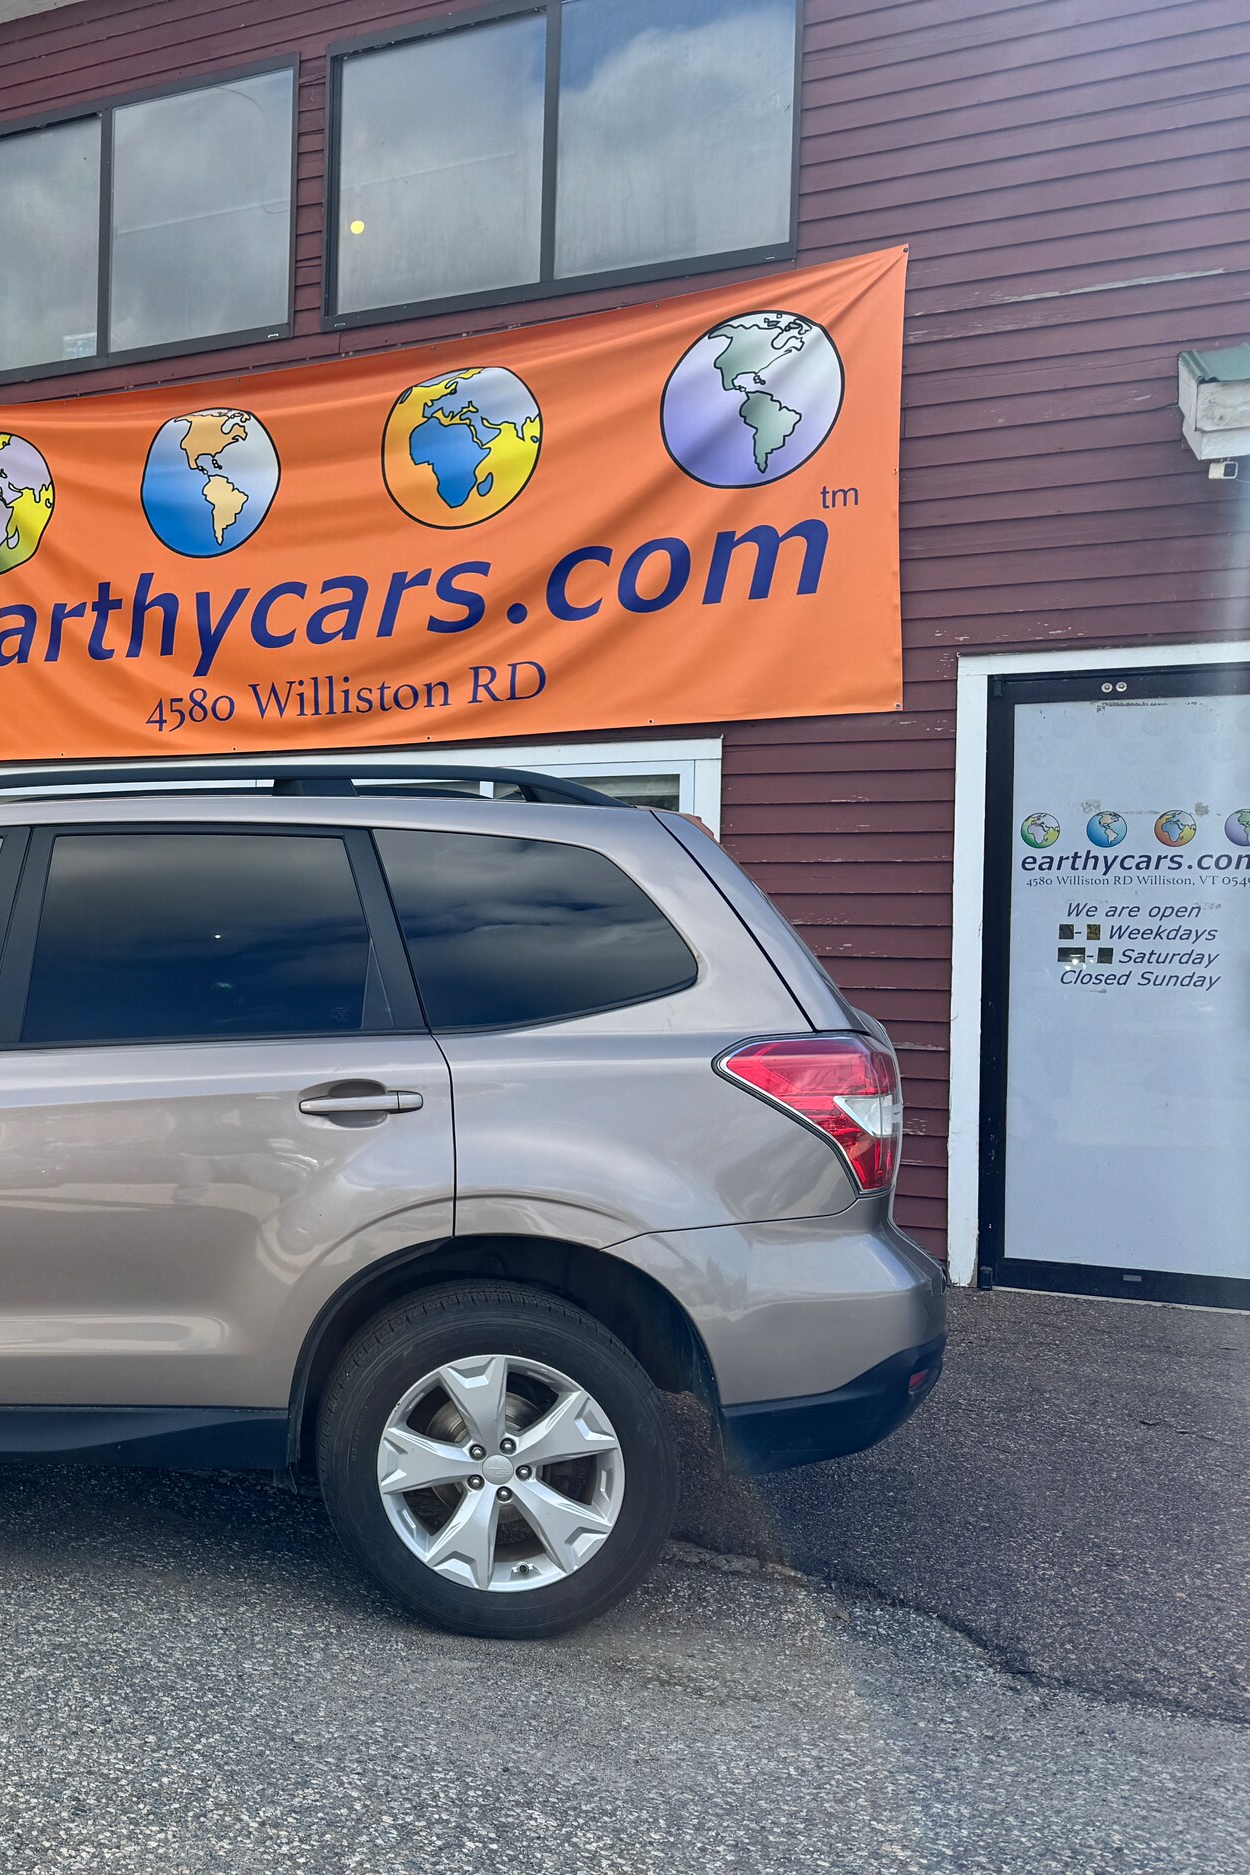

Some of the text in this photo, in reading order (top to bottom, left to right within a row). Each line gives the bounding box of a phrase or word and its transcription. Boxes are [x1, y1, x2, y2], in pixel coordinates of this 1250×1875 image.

[820, 486, 859, 509] tm
[145, 660, 546, 733] 4580 Williston RD
[1026, 876, 1053, 887] 4580
[1056, 875, 1109, 886] Williston
[1113, 875, 1133, 885] RD
[1137, 875, 1195, 886] Williston,
[1199, 875, 1218, 885] VT
[1066, 902, 1201, 921] We are open
[1109, 925, 1218, 944] Weekdays
[1118, 949, 1220, 968] Saturday
[1060, 970, 1221, 991] Closed Sunday
